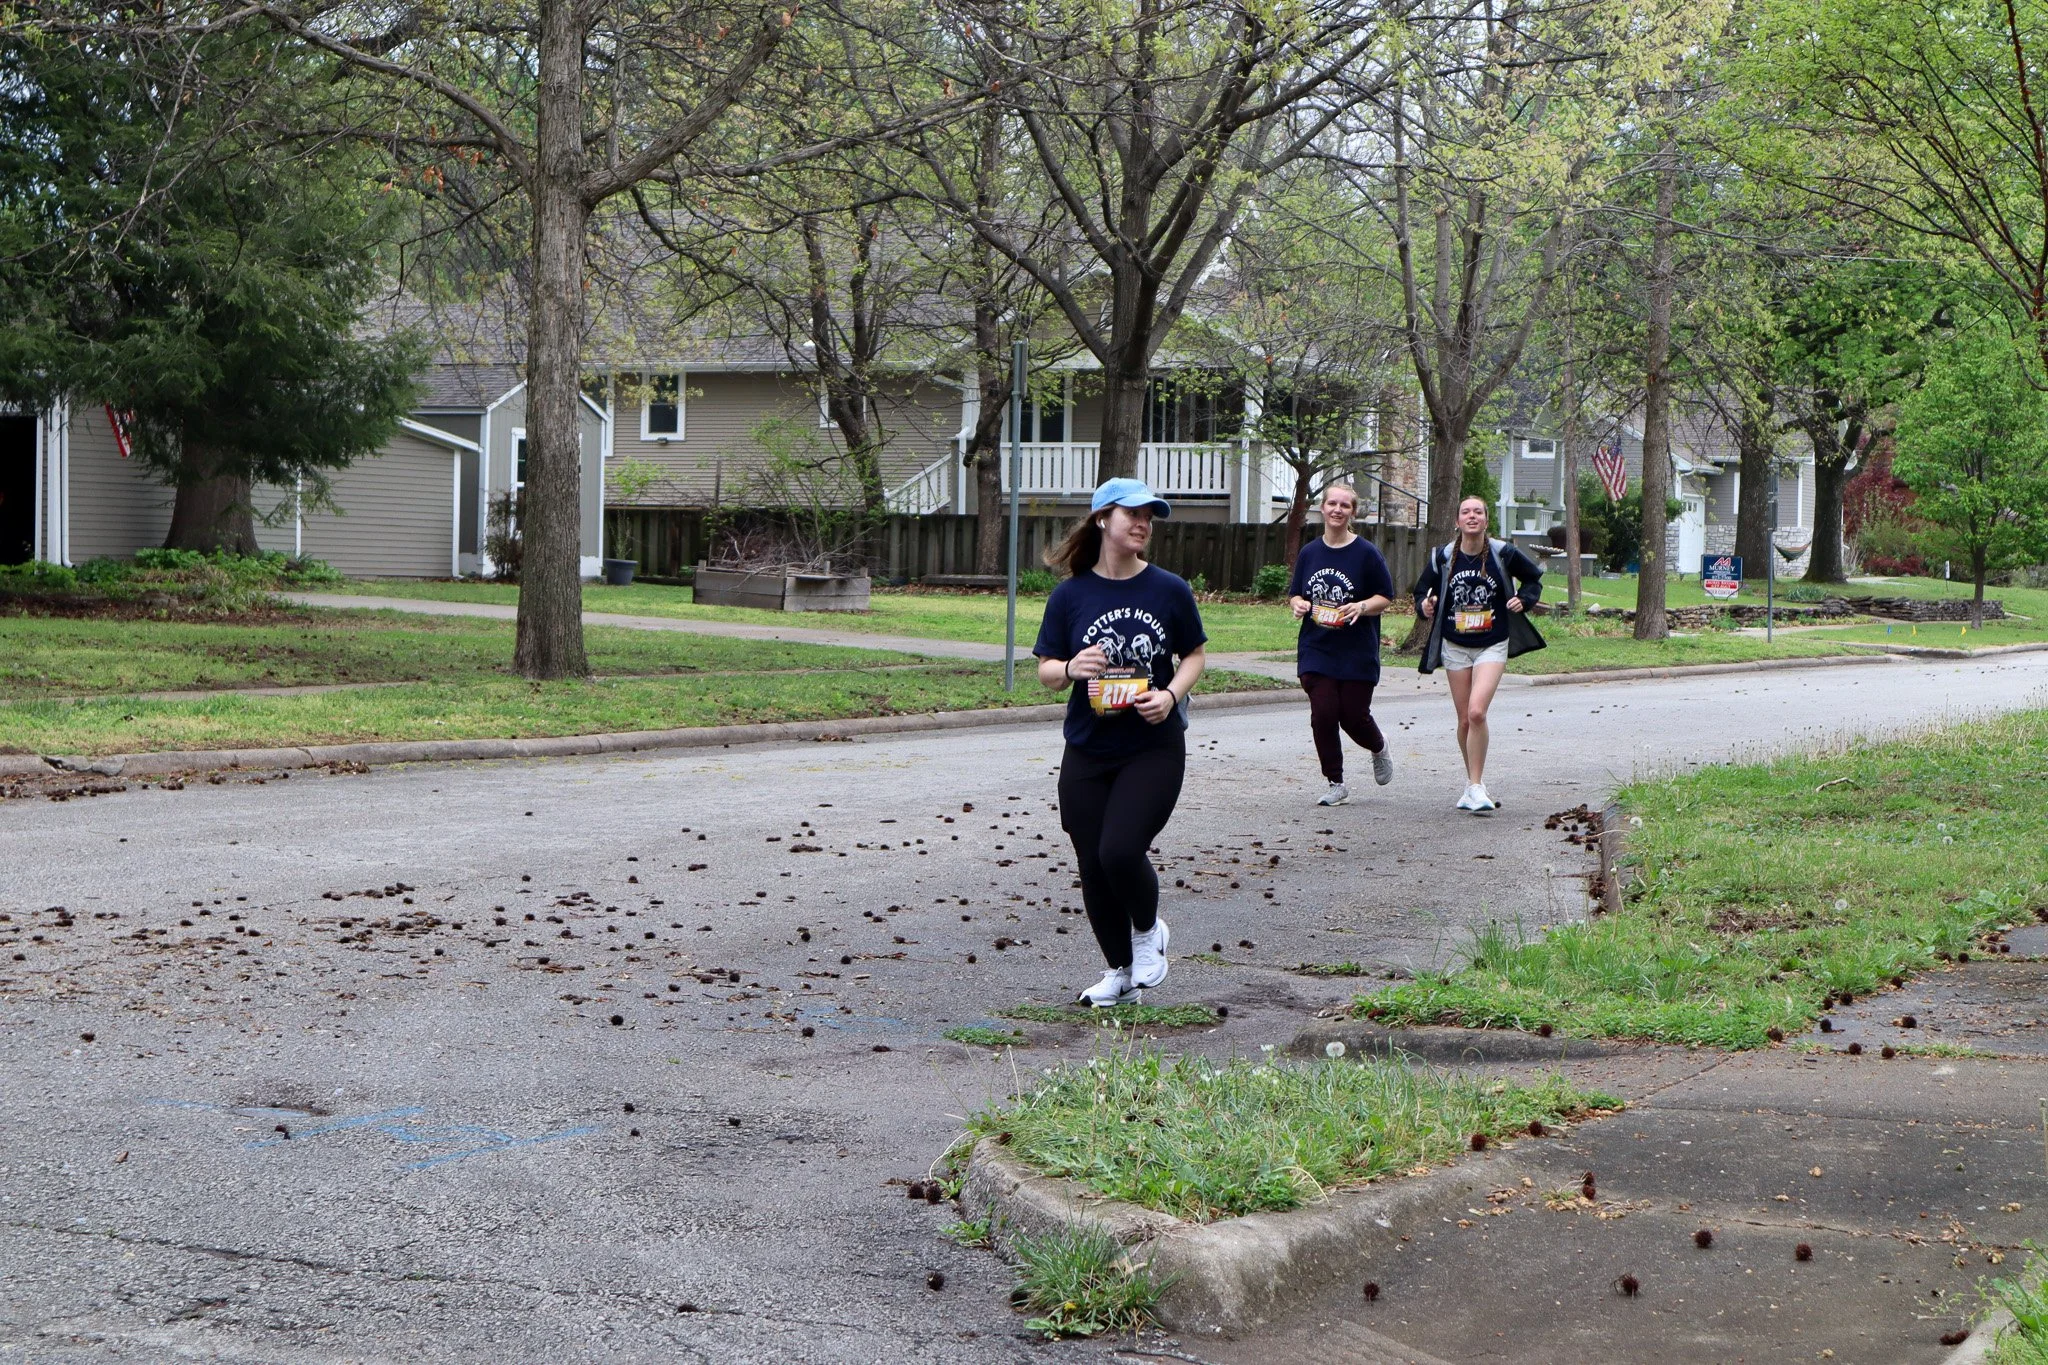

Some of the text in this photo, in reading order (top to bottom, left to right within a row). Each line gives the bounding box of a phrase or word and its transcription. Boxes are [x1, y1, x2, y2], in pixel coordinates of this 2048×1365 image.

[1307, 568, 1355, 591] POTTER'S HOUSE
[1082, 607, 1166, 645] POTTER'S HOUSE
[1101, 683, 1139, 705] 2172
